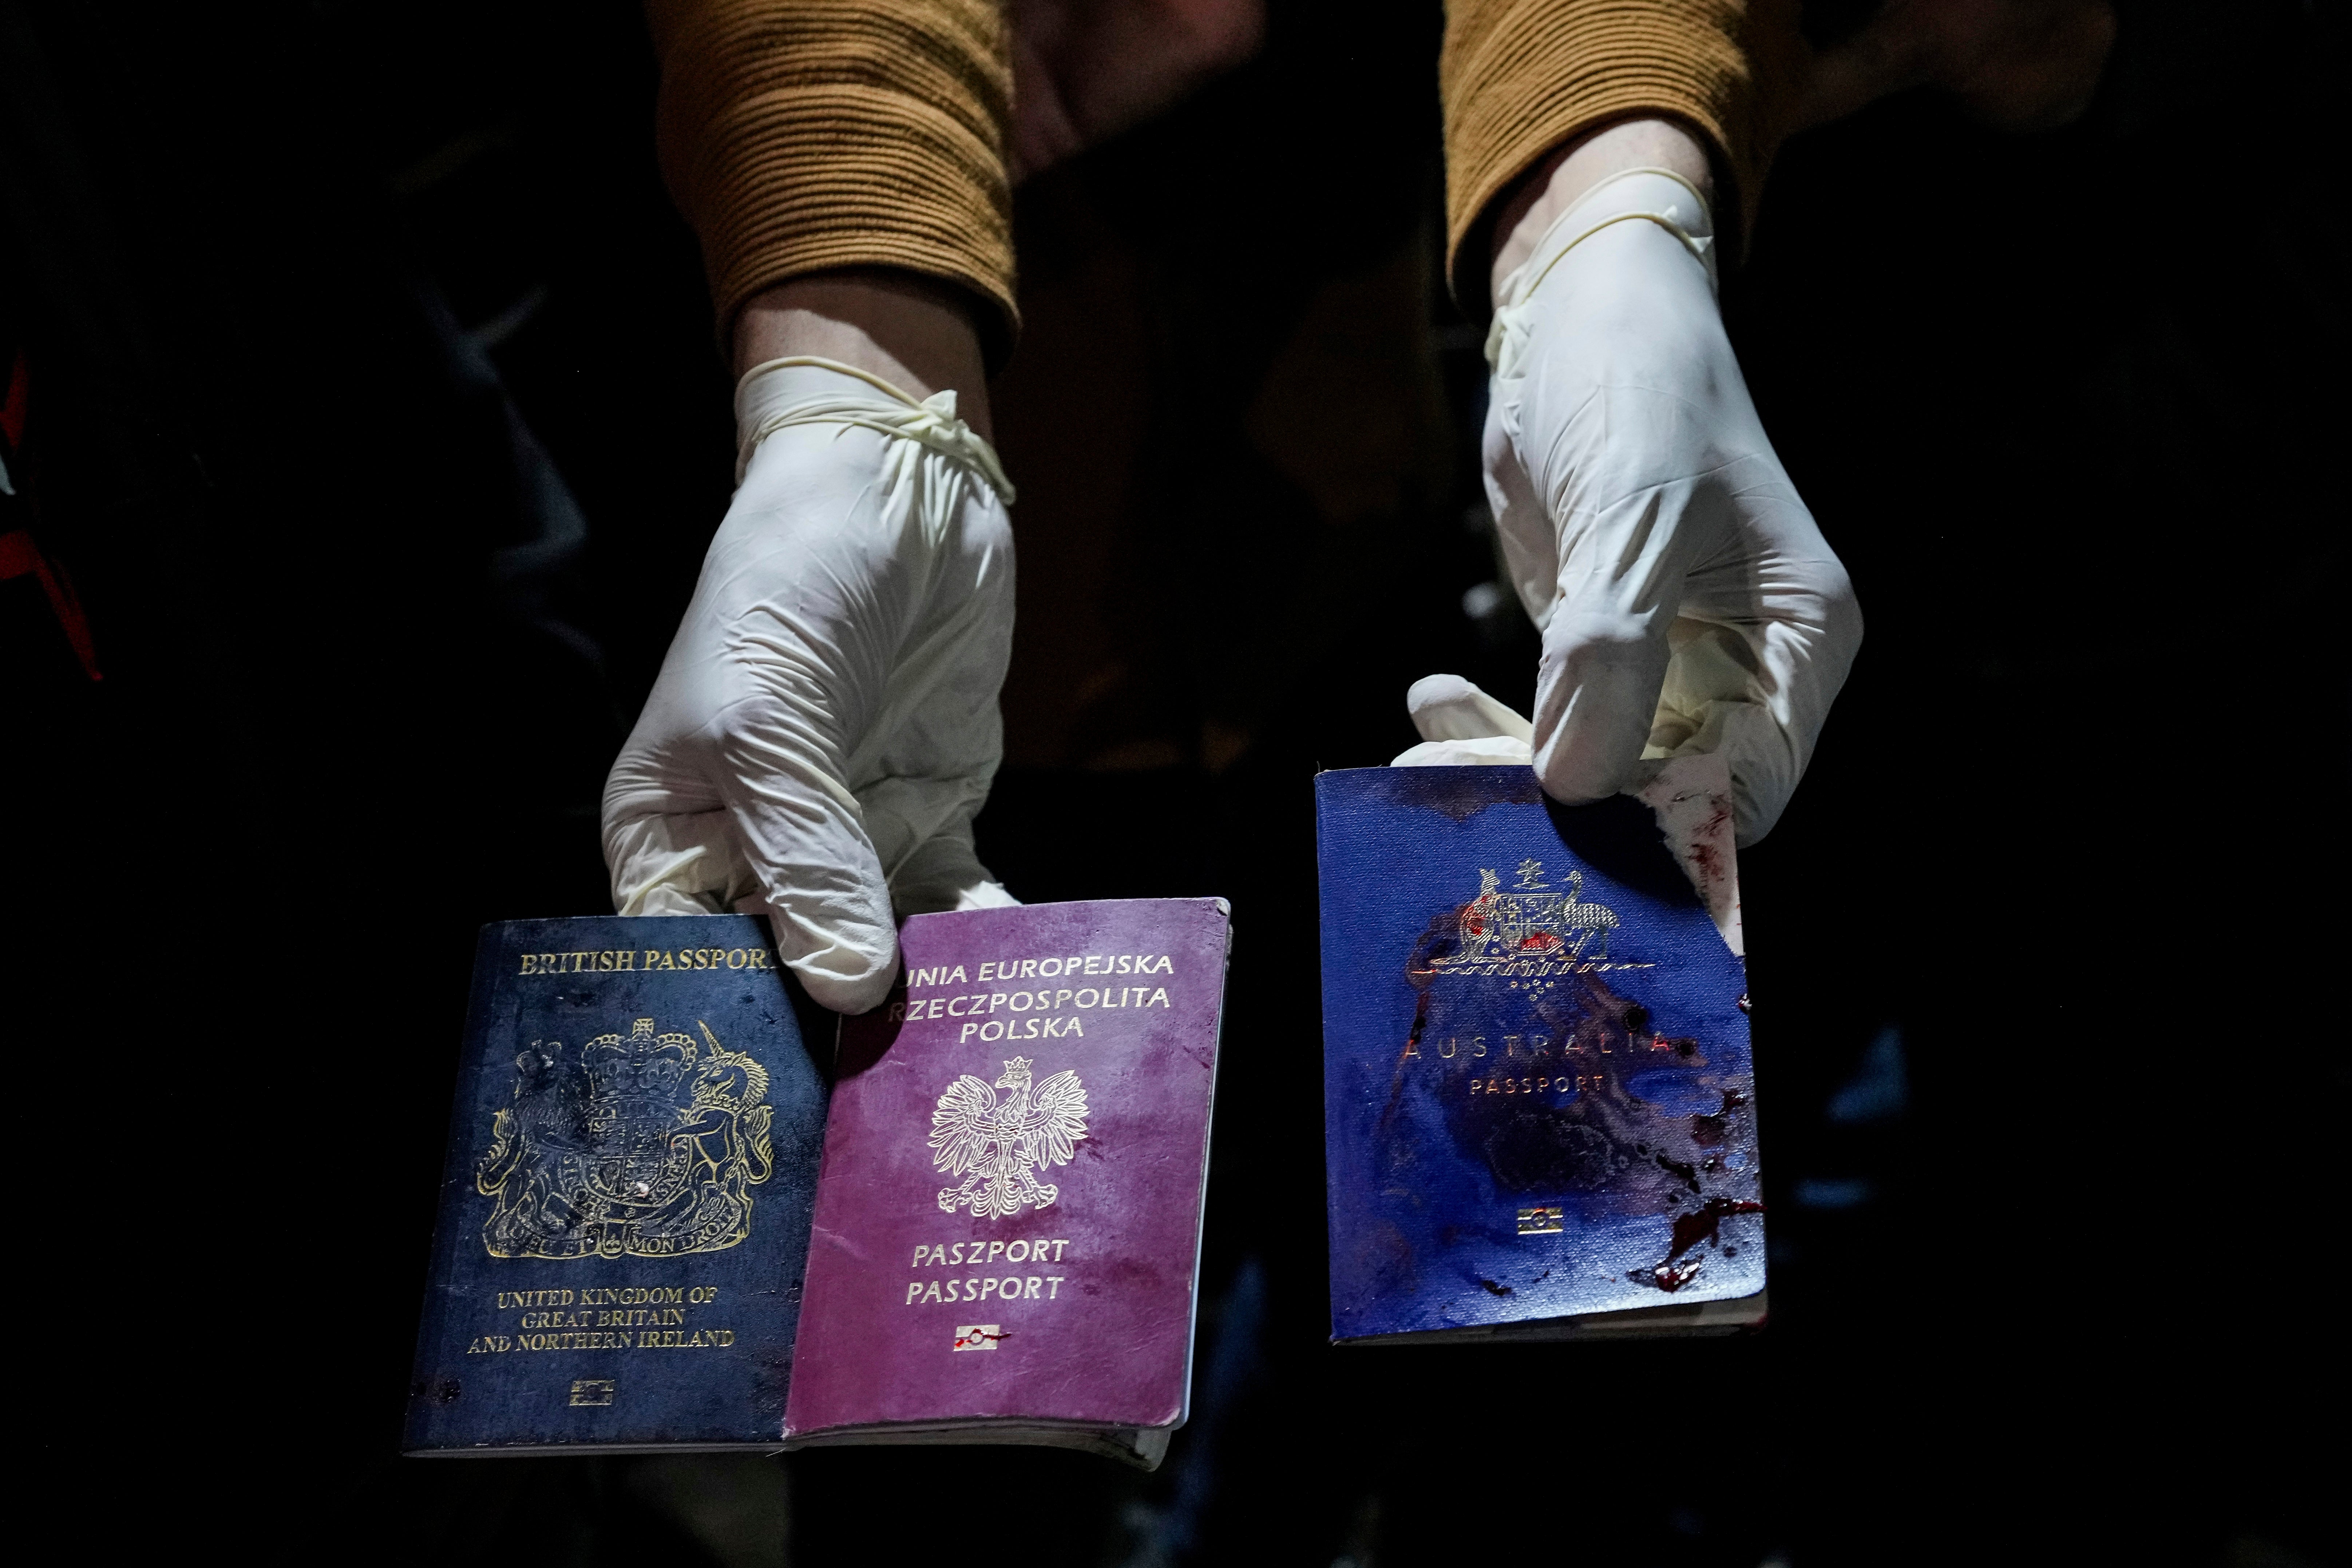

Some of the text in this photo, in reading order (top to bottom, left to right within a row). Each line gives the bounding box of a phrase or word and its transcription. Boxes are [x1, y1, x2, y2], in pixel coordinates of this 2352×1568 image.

[519, 950, 636, 975] BRITISH
[978, 955, 1174, 982] EUROPEJSKA
[888, 987, 1171, 1022] RZECZPOSPOLITA
[960, 1016, 1084, 1044] POLSKA
[1404, 1031, 1670, 1060] AUSTRALIA
[1470, 1076, 1603, 1095] PASSPORT
[629, 1234, 676, 1253] MON
[912, 1239, 1069, 1268] PASZPORT
[498, 1286, 718, 1309] UNITED KINGDOM OF
[906, 1276, 1064, 1305] PASSPORT
[522, 1309, 686, 1329] GREAT BRITAIN
[467, 1330, 735, 1354] AND NORTHERN IRELAND
